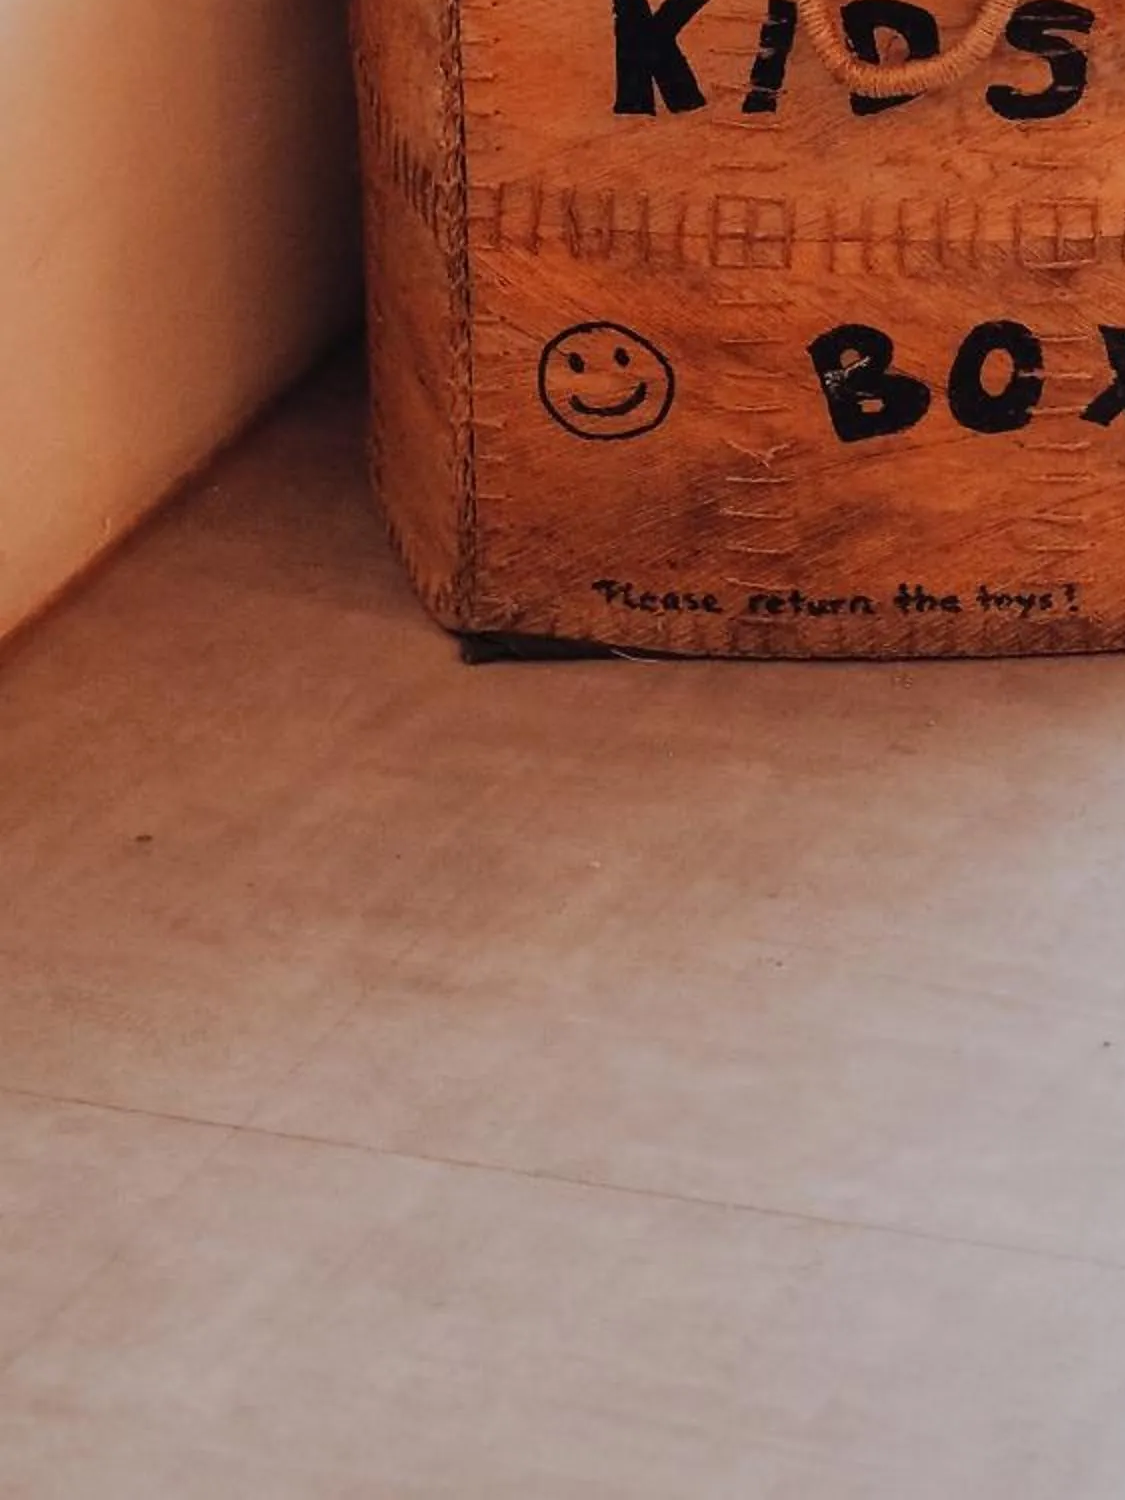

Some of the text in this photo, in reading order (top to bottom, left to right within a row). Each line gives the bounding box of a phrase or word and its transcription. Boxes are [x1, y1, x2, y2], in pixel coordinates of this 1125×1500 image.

[591, 579, 1079, 618] Please return the toys!
